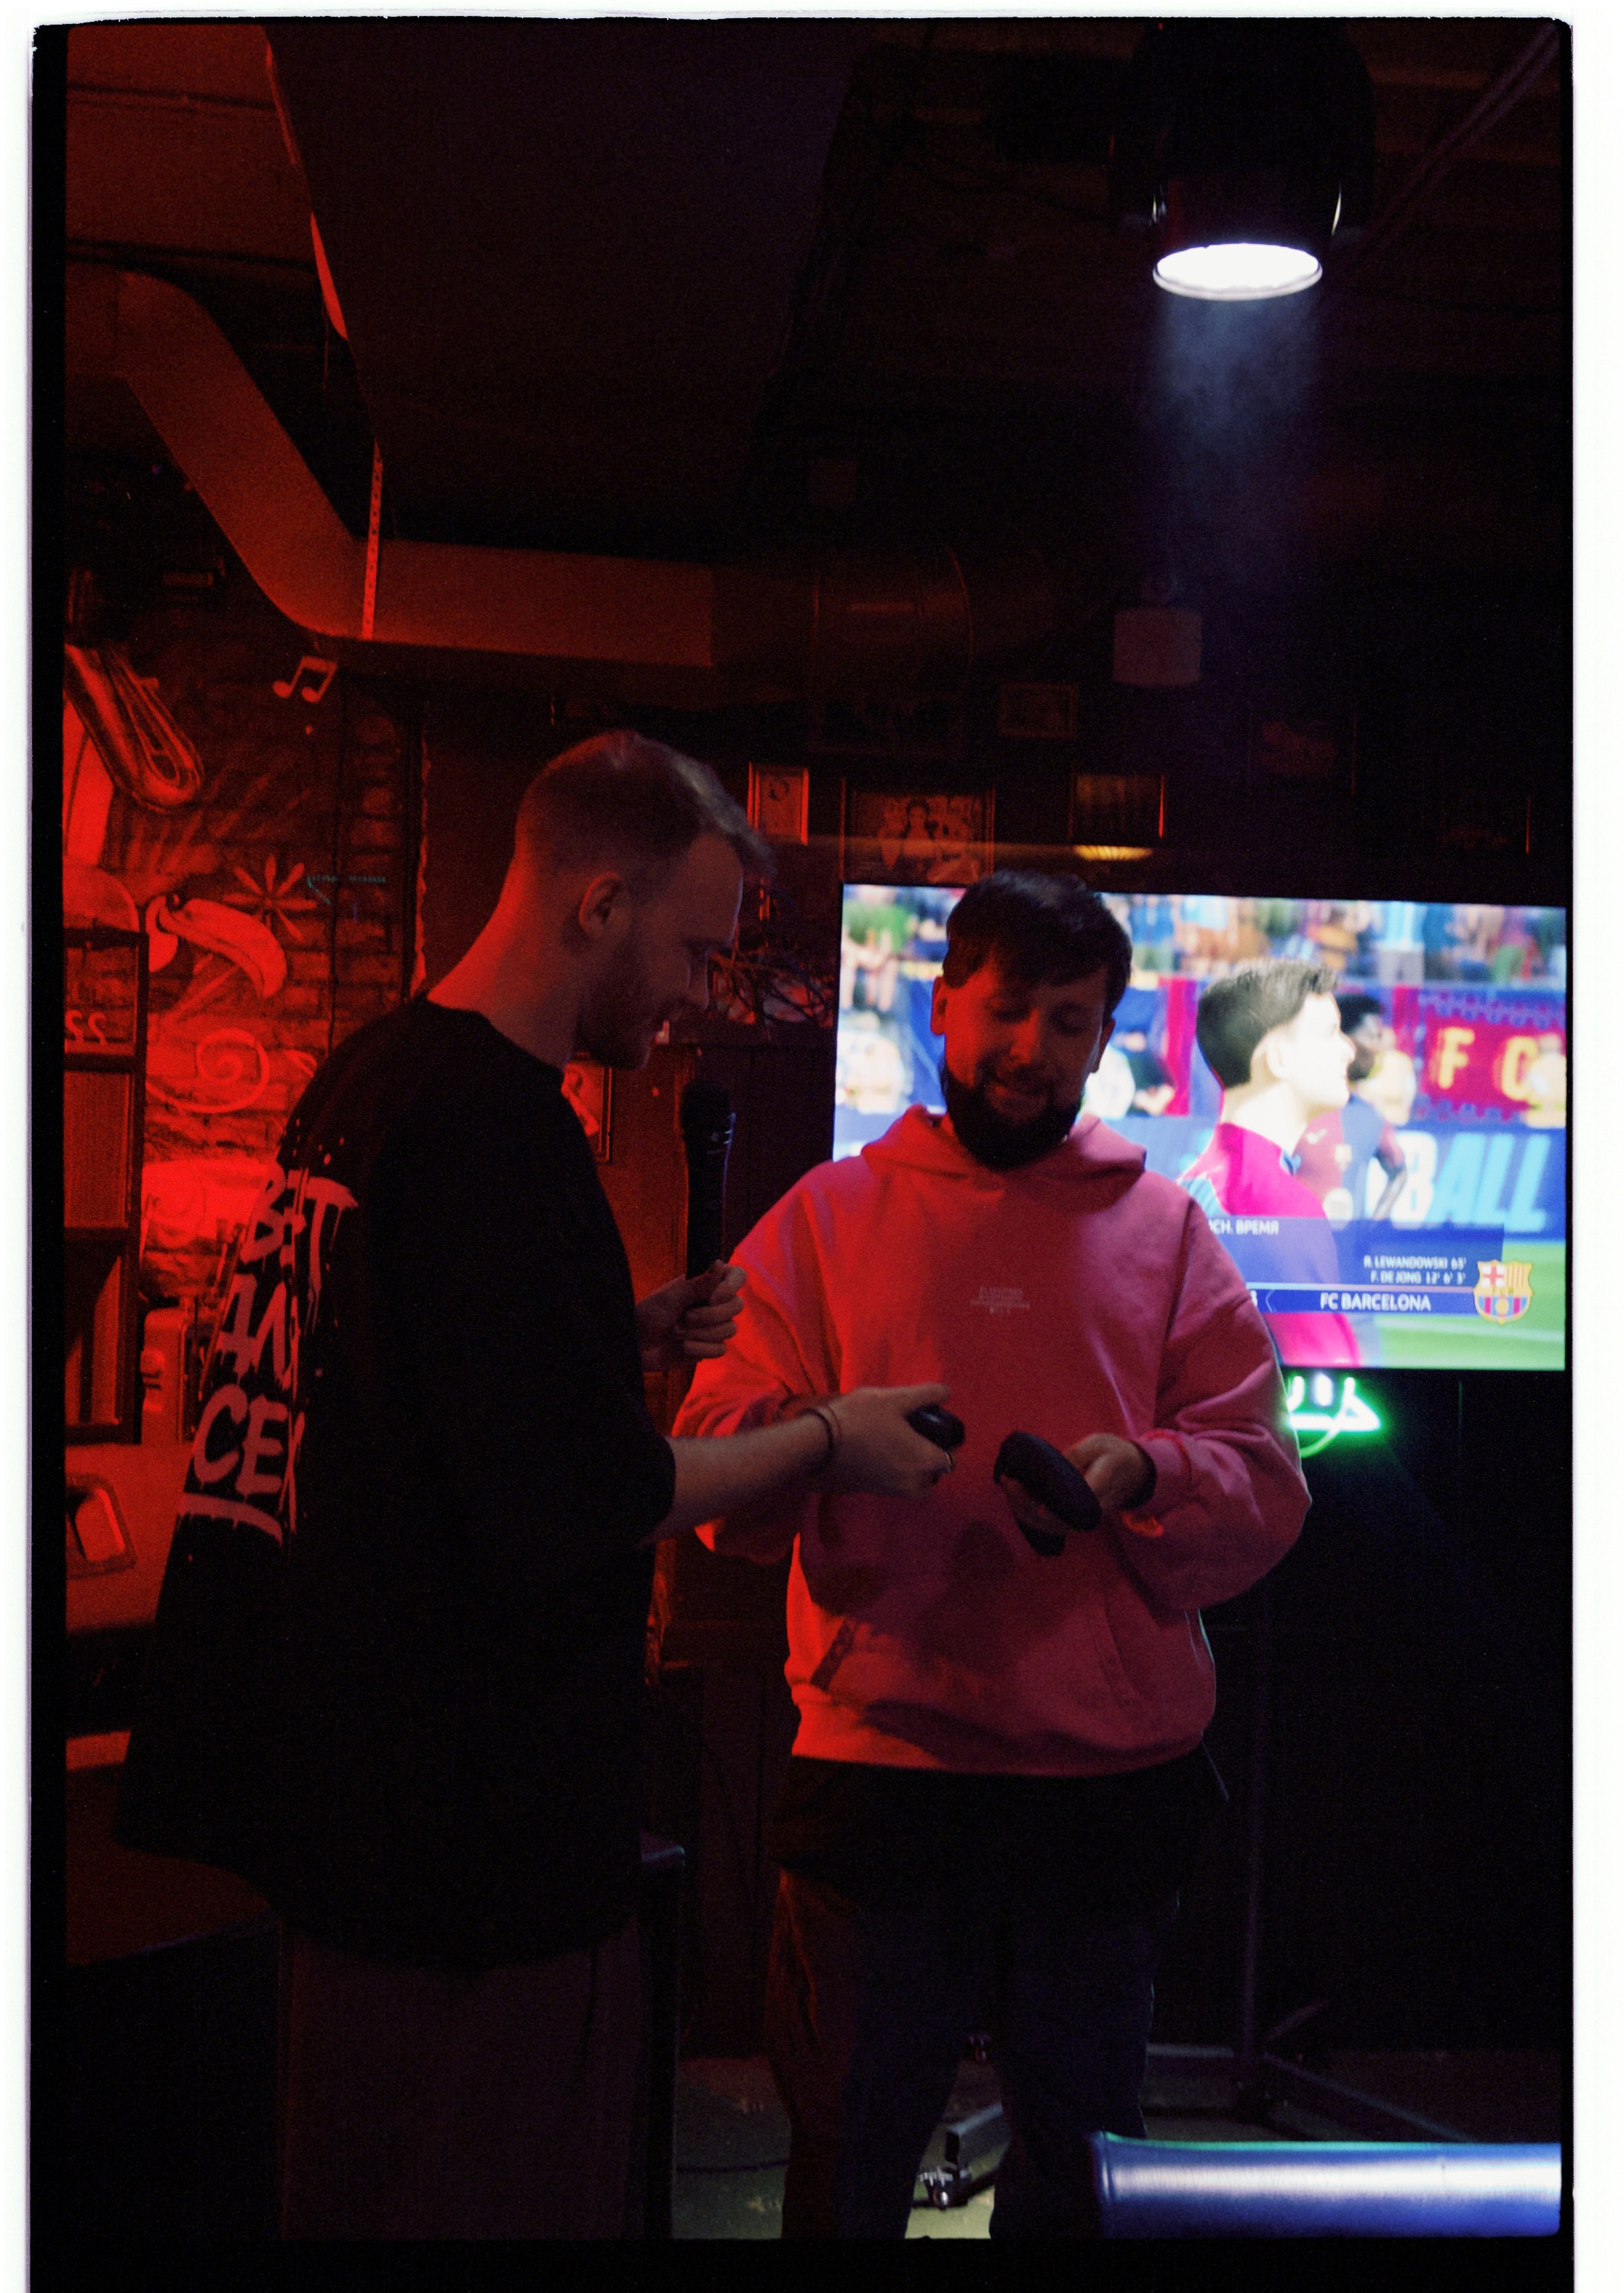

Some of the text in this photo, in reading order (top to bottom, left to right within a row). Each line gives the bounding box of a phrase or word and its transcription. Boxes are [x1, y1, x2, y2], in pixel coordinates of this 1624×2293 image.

[1236, 1219, 1279, 1235] ВРЕМЯ
[1375, 1256, 1448, 1270] LEWANDOWSKI
[1380, 1270, 1394, 1284] DE
[1396, 1271, 1422, 1284] JONG
[1320, 1292, 1432, 1311] FC BARCELONA
